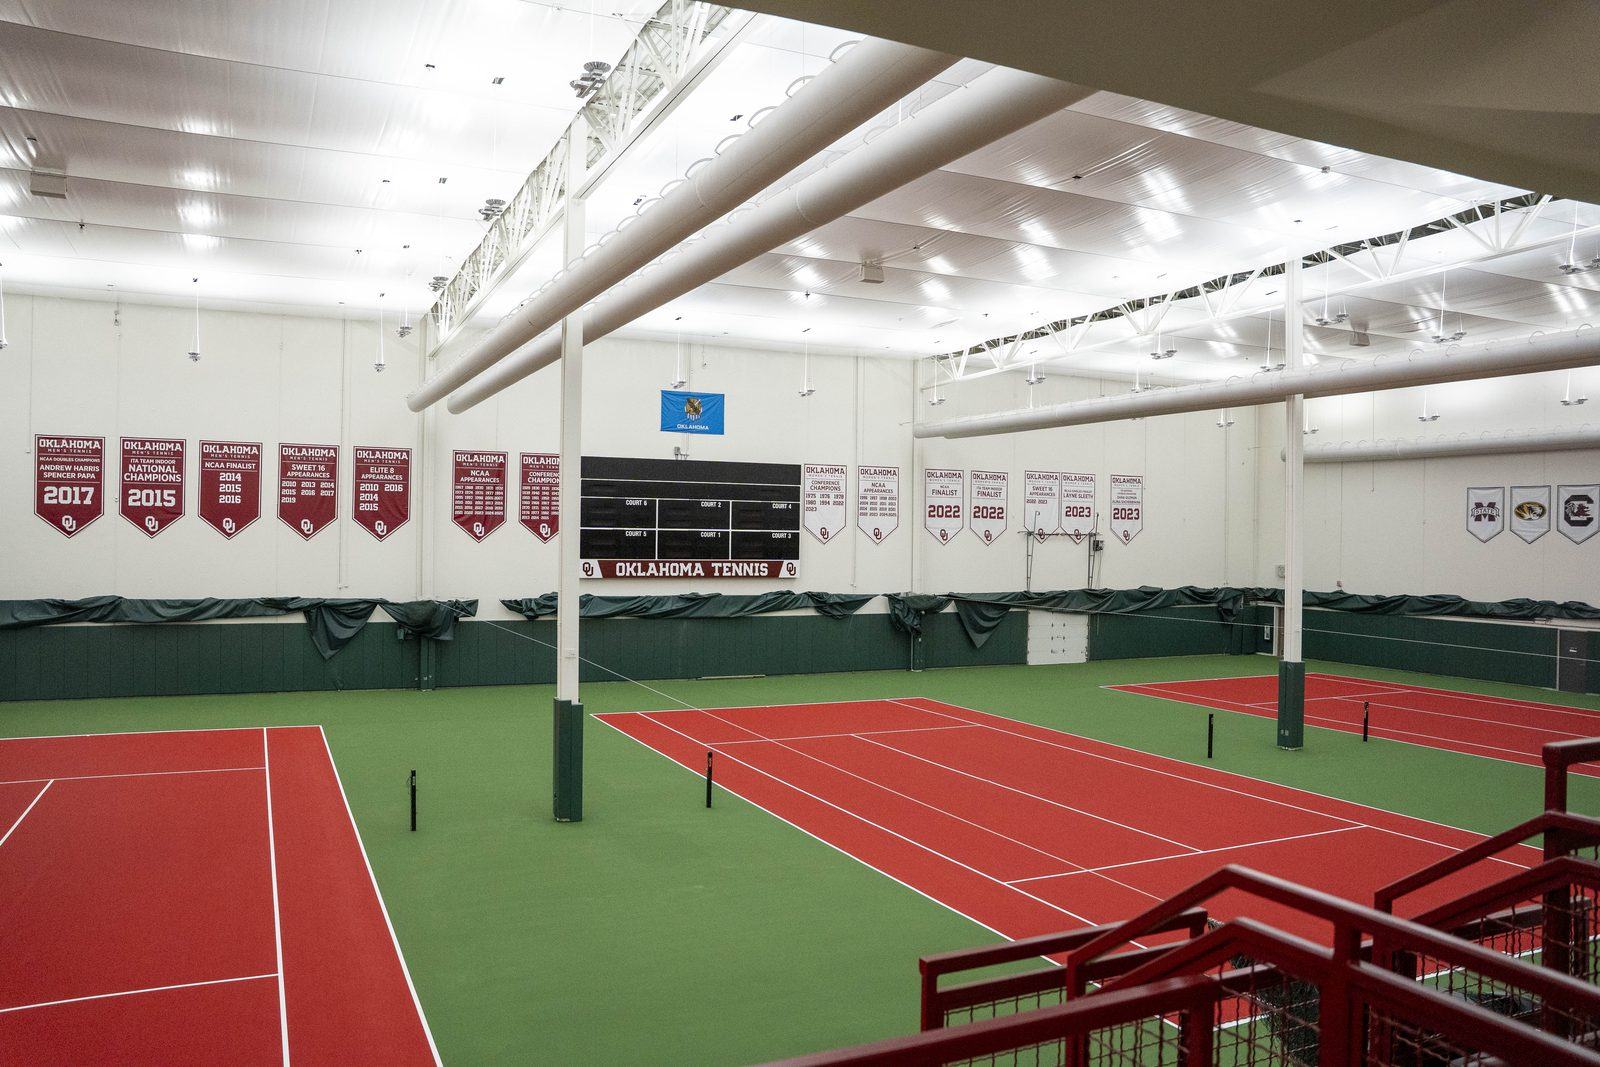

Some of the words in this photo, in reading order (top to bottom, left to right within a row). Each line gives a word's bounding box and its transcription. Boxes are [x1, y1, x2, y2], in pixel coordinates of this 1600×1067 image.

[40, 438, 100, 450] OKLAHOMA
[124, 441, 182, 452] OKLAHOMA
[203, 444, 258, 454] OKLAHOMA
[282, 448, 336, 457] OKLAHOMA
[357, 450, 408, 460] OKLAHOMA
[456, 454, 504, 463] OKLAHOMA
[128, 464, 178, 474] NATIONAL
[806, 466, 845, 474] OKLAHOMA
[124, 472, 182, 482] CHAMPIONS
[220, 472, 241, 482] 2014
[220, 484, 241, 492] 2015
[360, 484, 378, 492] 2010
[384, 484, 403, 492] 2016
[44, 486, 94, 505] 2017
[128, 488, 176, 507] 2015
[219, 495, 241, 504] 2016
[360, 494, 378, 502] 2014
[360, 503, 378, 511] 2015
[928, 504, 960, 518] 2022
[974, 506, 1004, 520] 2022
[1066, 506, 1090, 518] 2023
[1113, 508, 1140, 520] 2023
[62, 515, 76, 532] OU
[145, 516, 158, 532] OU
[222, 518, 236, 533] OU
[300, 518, 314, 534] OU
[375, 520, 386, 535] OU
[474, 522, 484, 536] OU
[540, 524, 550, 537] OU
[820, 527, 828, 540] OU
[874, 528, 882, 540] OU
[940, 528, 948, 541] OU
[984, 530, 992, 542] OU
[1122, 530, 1130, 541] OU
[582, 562, 594, 576] OU
[616, 562, 704, 577] OKLAHOMA
[712, 562, 768, 577] TENNIS
[786, 562, 796, 576] OU
